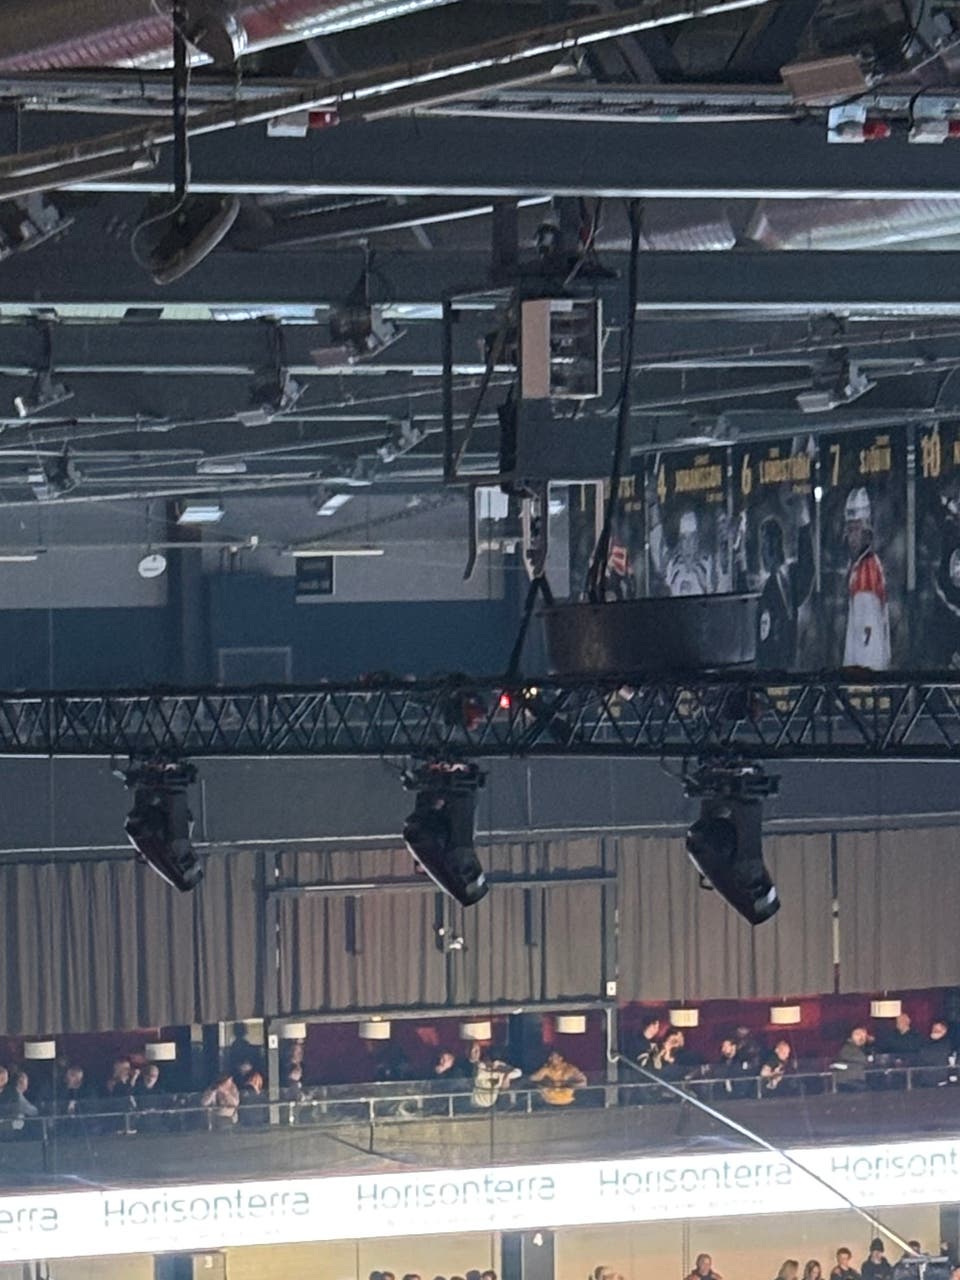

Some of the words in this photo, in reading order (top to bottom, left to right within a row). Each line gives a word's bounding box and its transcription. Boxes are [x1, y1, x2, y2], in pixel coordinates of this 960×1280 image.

[104, 1189, 310, 1227] Horisonterra
[357, 1175, 556, 1211] Horisonterra
[599, 1161, 792, 1196] Horisonterra
